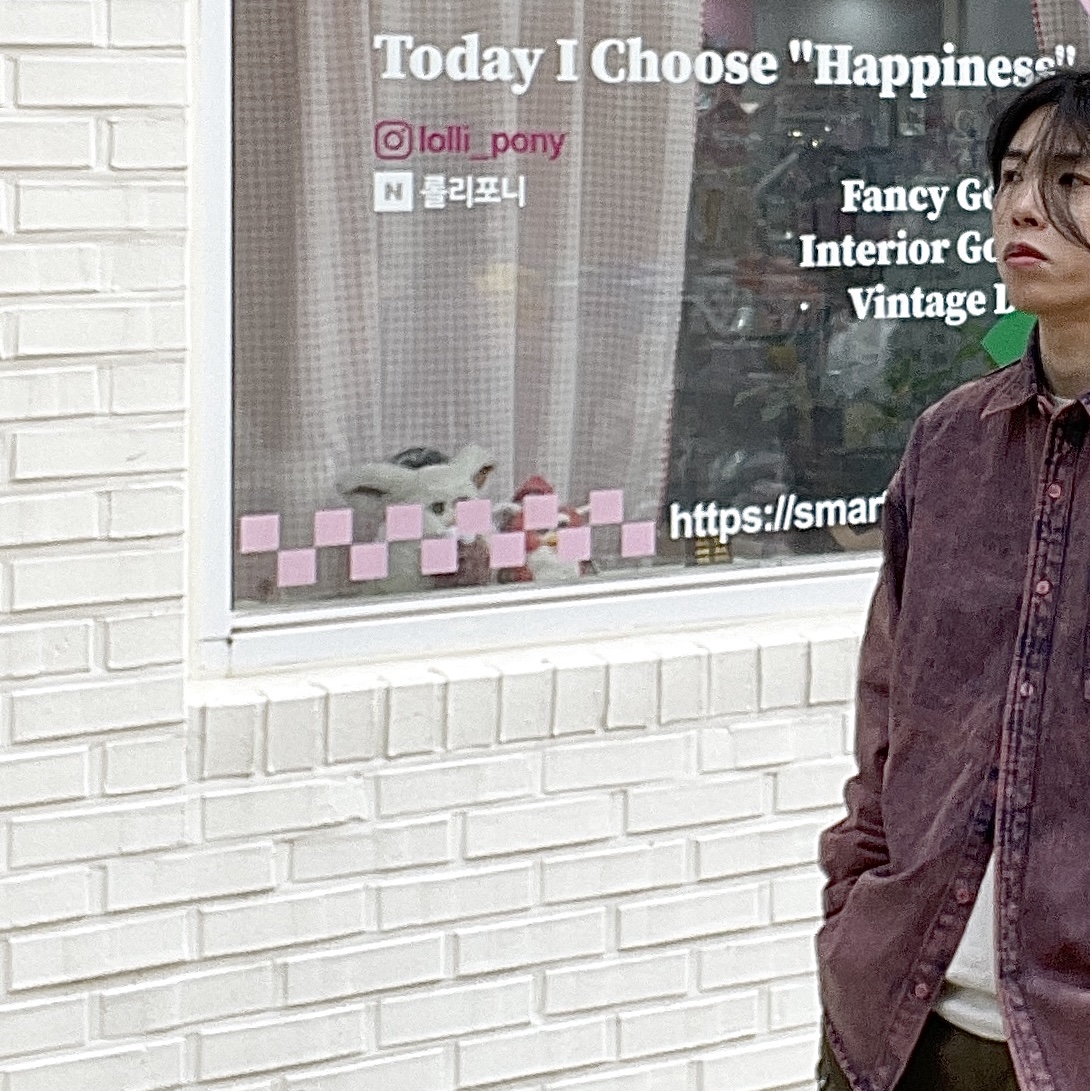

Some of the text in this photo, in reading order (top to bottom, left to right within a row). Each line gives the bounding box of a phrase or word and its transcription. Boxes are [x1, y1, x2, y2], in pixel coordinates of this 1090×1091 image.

[373, 34, 543, 95] Today
[556, 39, 579, 83] I
[590, 38, 779, 84] Choose
[418, 125, 567, 161] lolli_pony
[841, 178, 950, 221] Fancy
[799, 229, 950, 268] Interior
[847, 283, 986, 326] Vintage
